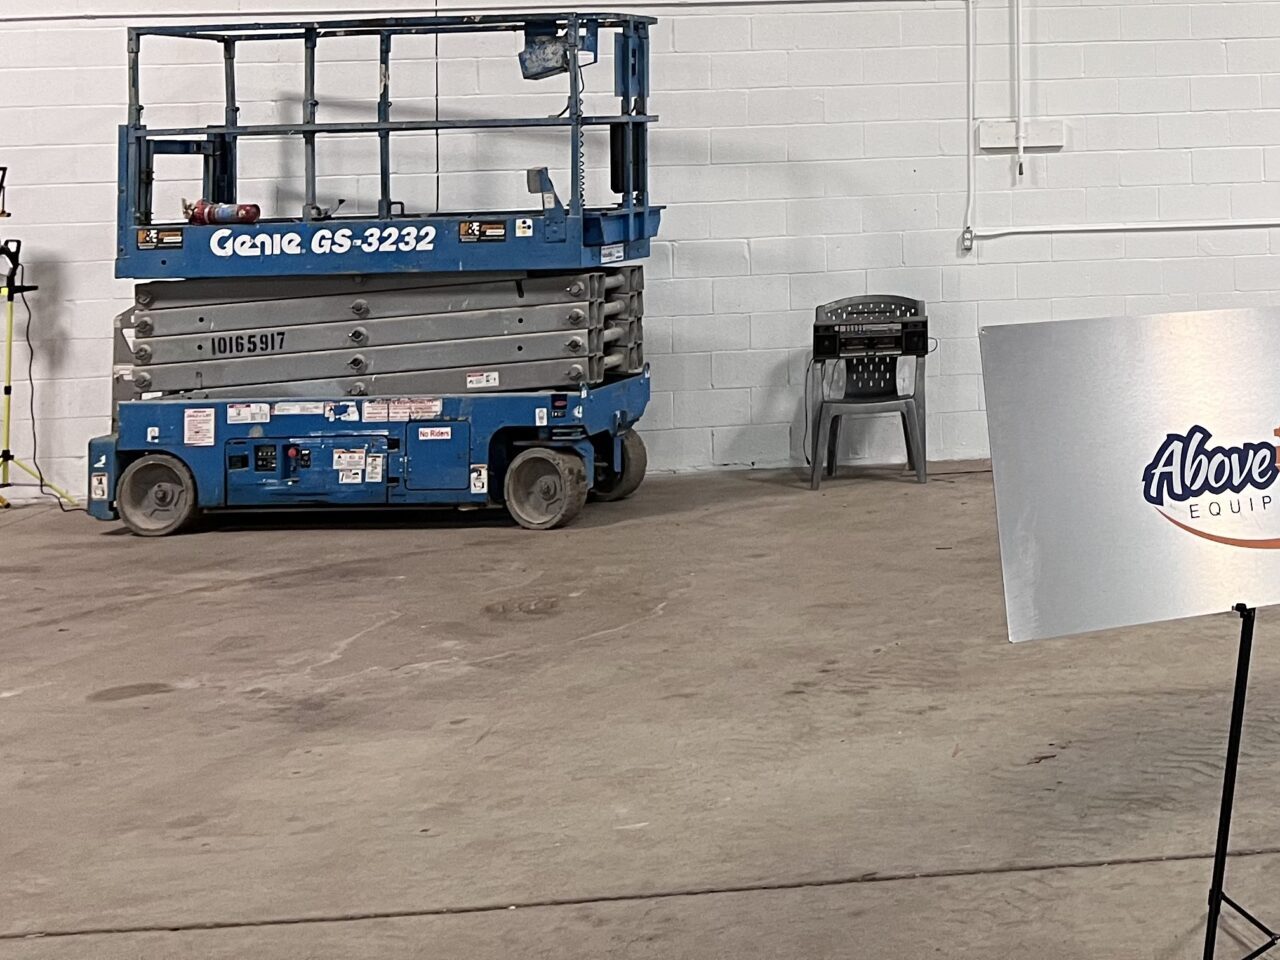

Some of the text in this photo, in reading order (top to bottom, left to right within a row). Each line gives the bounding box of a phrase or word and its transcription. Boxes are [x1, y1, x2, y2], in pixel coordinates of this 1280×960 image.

[210, 228, 303, 257] Genie
[311, 226, 437, 255] GS-3232
[211, 331, 286, 356] 10165917
[419, 428, 450, 438] No Riders
[1146, 427, 1276, 503] Above
